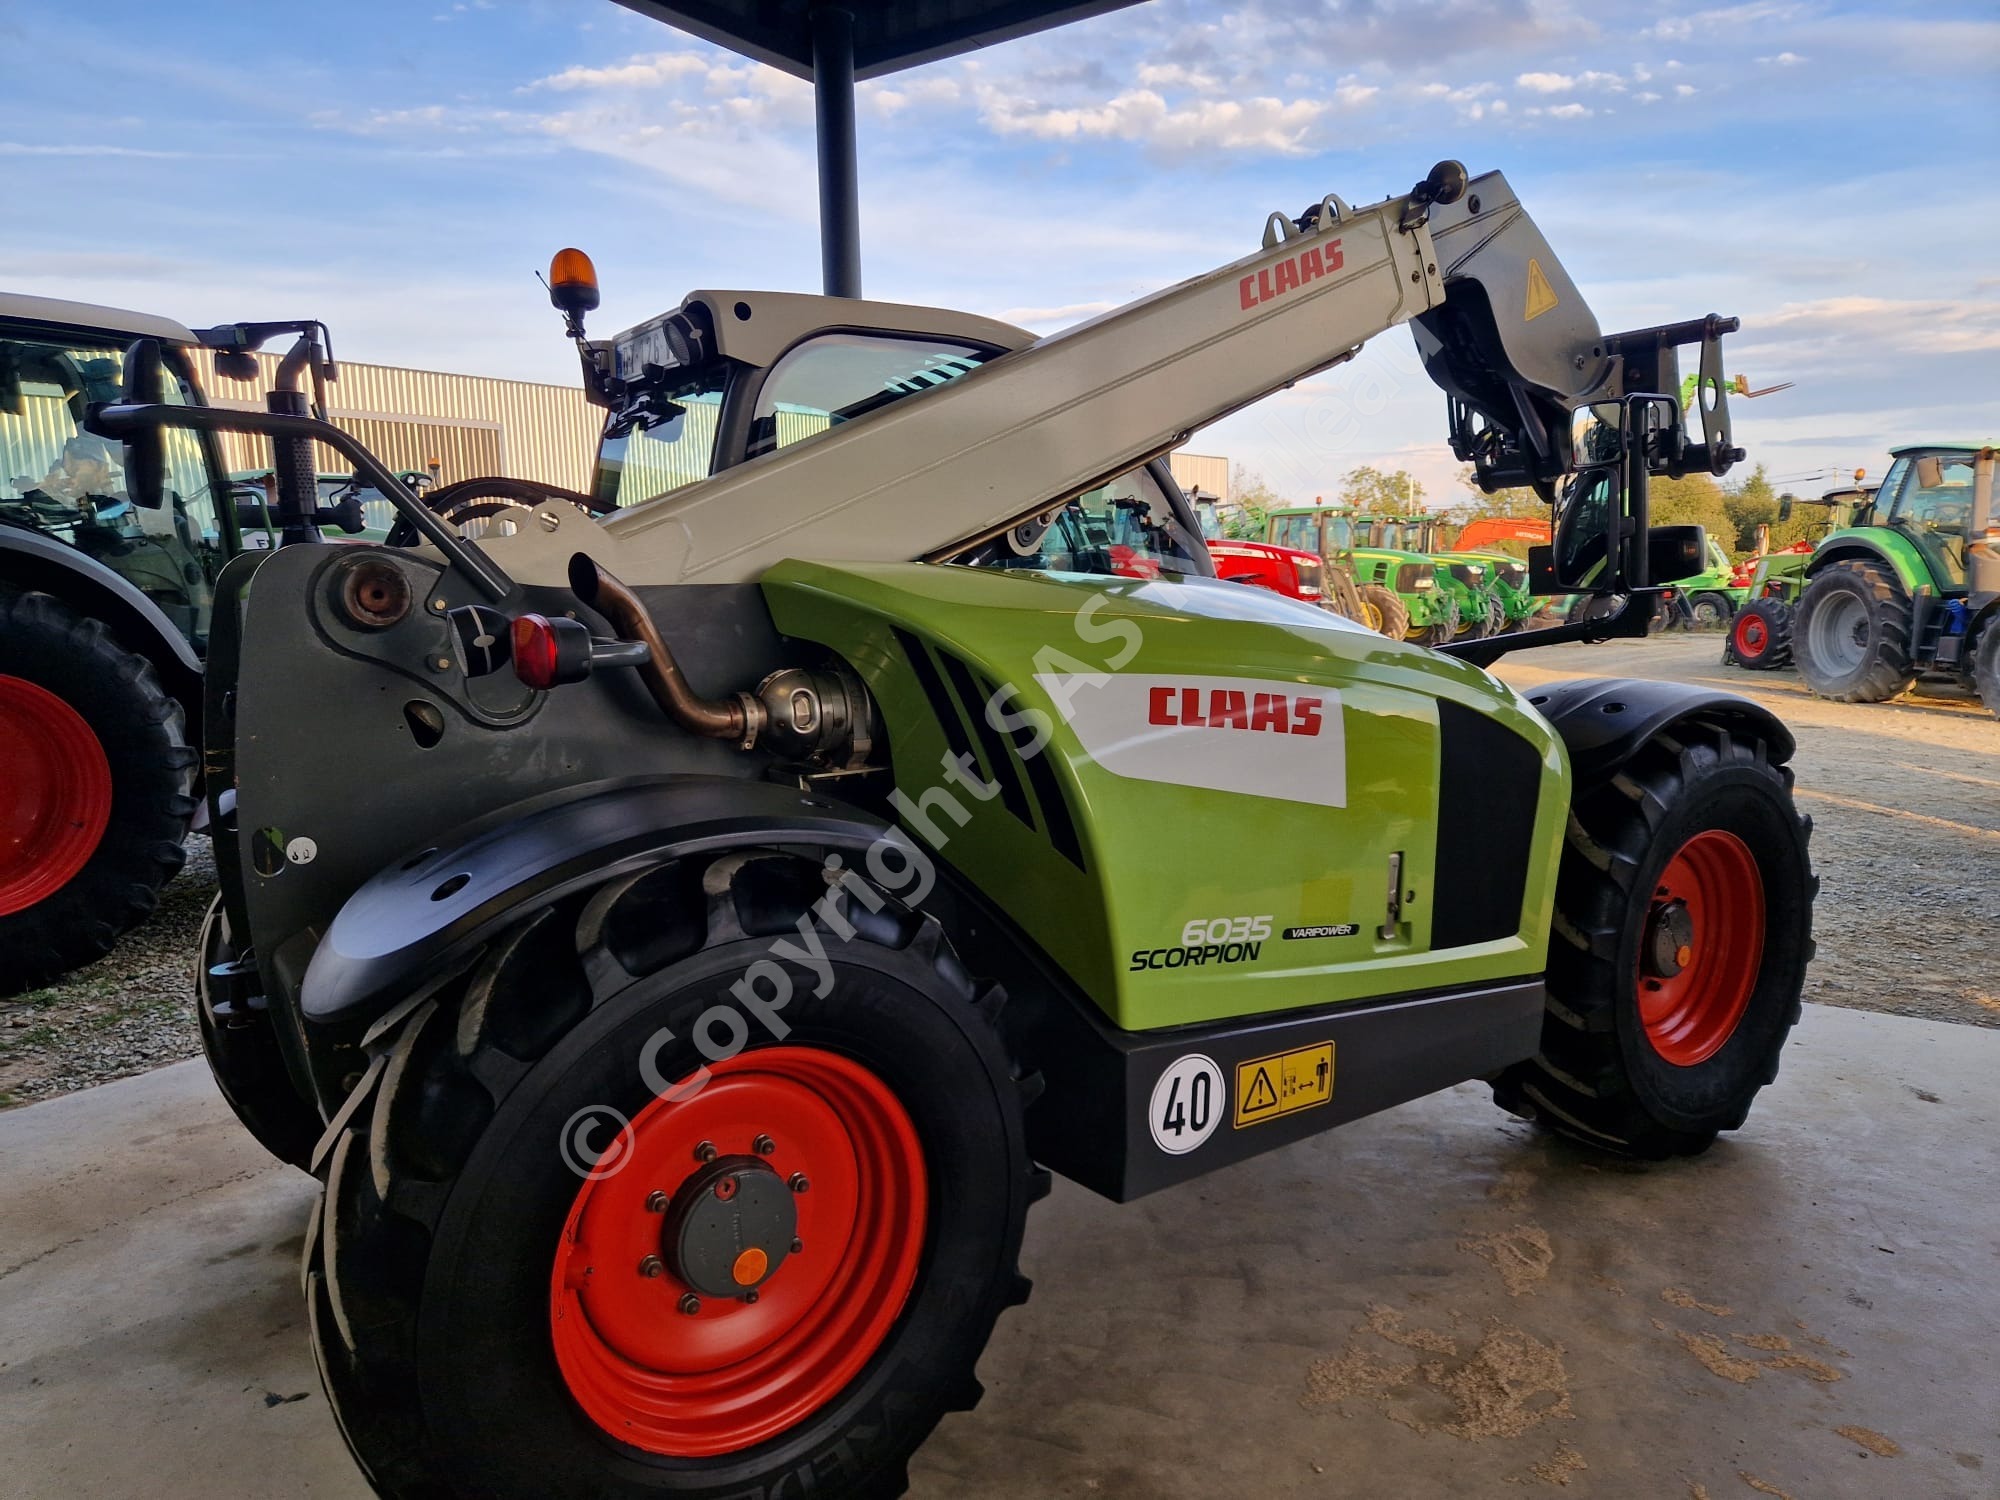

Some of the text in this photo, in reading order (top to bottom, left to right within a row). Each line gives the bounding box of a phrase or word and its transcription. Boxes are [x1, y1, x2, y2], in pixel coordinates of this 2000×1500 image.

[1239, 239, 1344, 311] CLAAS
[1148, 686, 1323, 737] CLAAS
[1181, 915, 1274, 948] 6035
[1291, 924, 1352, 939] VARIPOWER
[1129, 941, 1261, 972] SCORPION
[1162, 1071, 1211, 1137] 40
